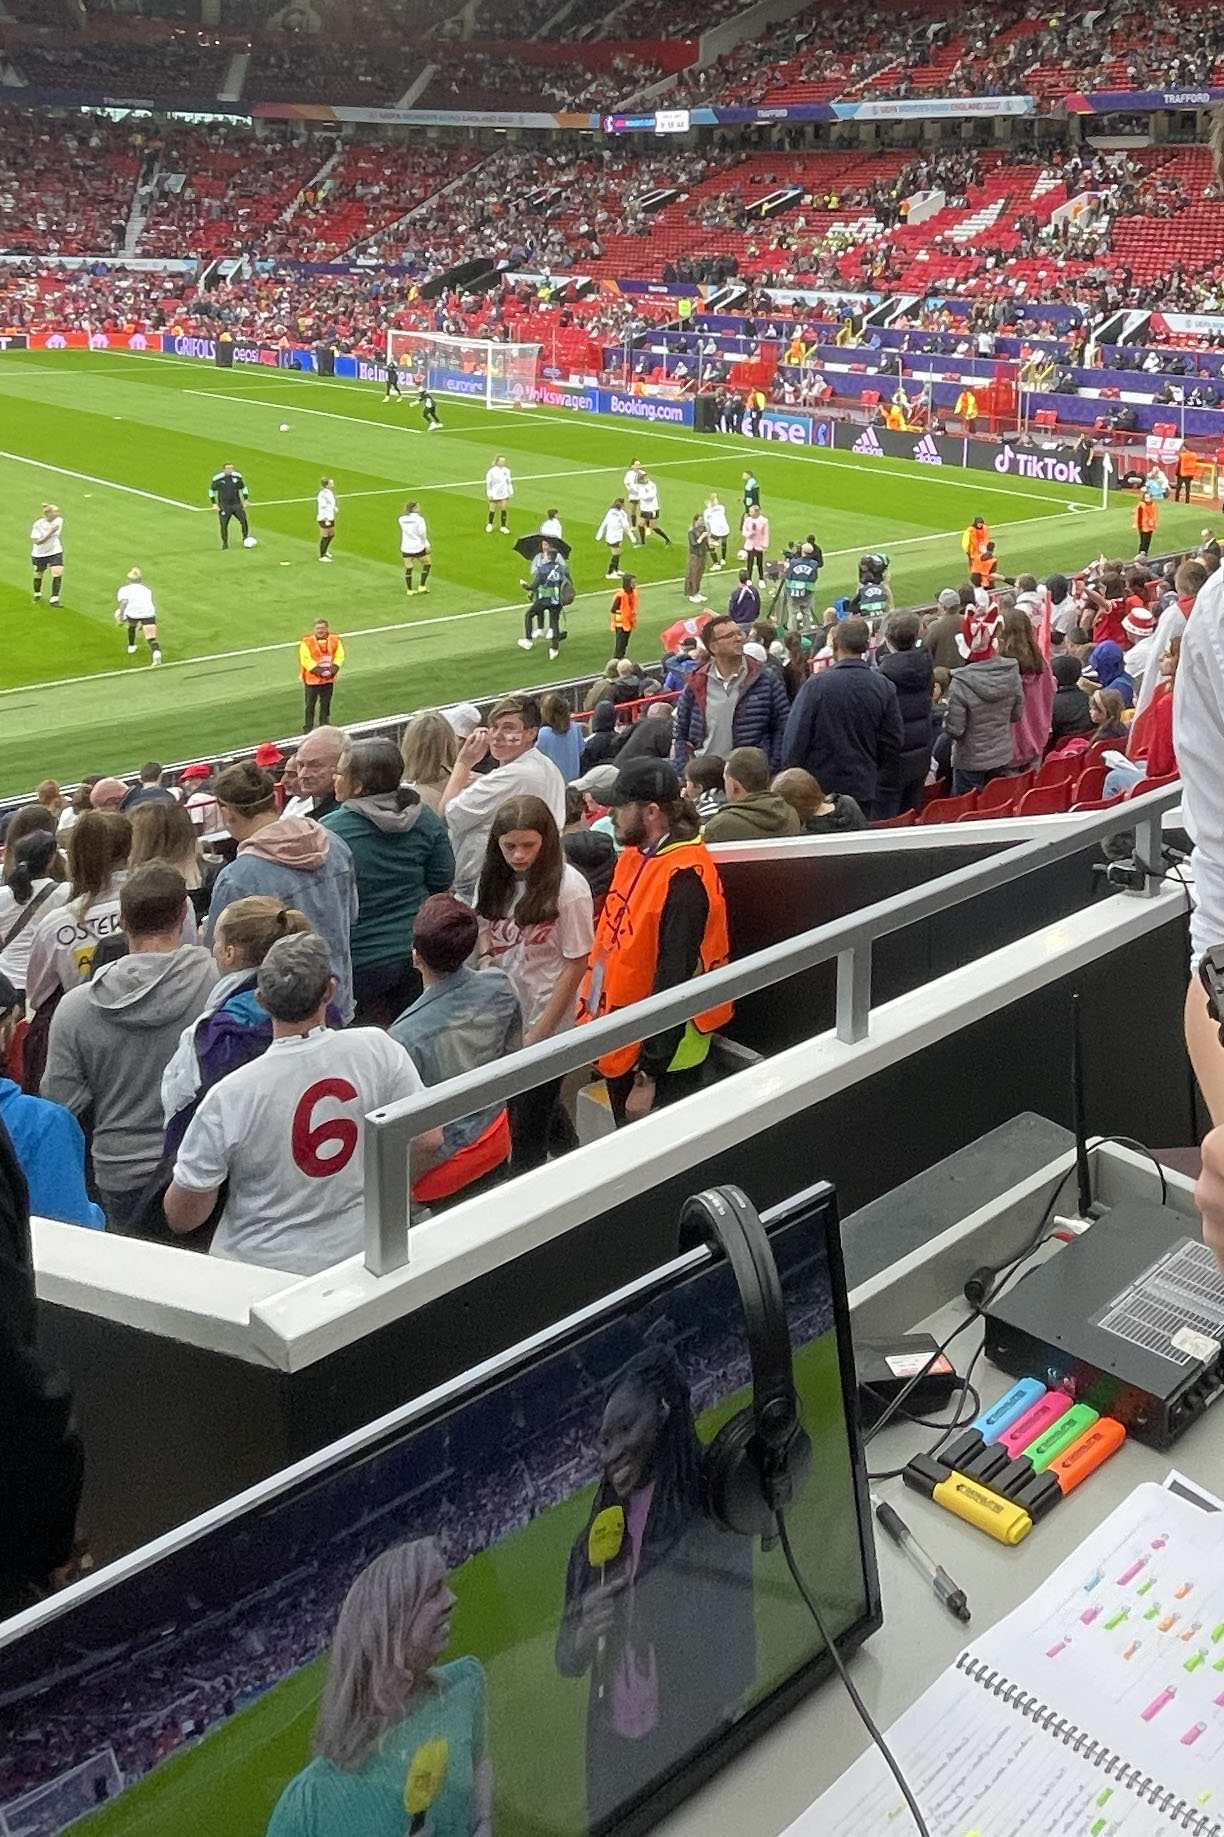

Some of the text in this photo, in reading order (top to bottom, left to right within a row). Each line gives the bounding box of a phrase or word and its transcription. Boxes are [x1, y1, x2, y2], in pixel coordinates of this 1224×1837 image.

[1163, 93, 1210, 104] TRAFFORD
[175, 336, 216, 360] GRIFOLS
[611, 396, 683, 422] Booking.com
[1016, 453, 1083, 484] TikTok
[291, 1077, 359, 1179] 6
